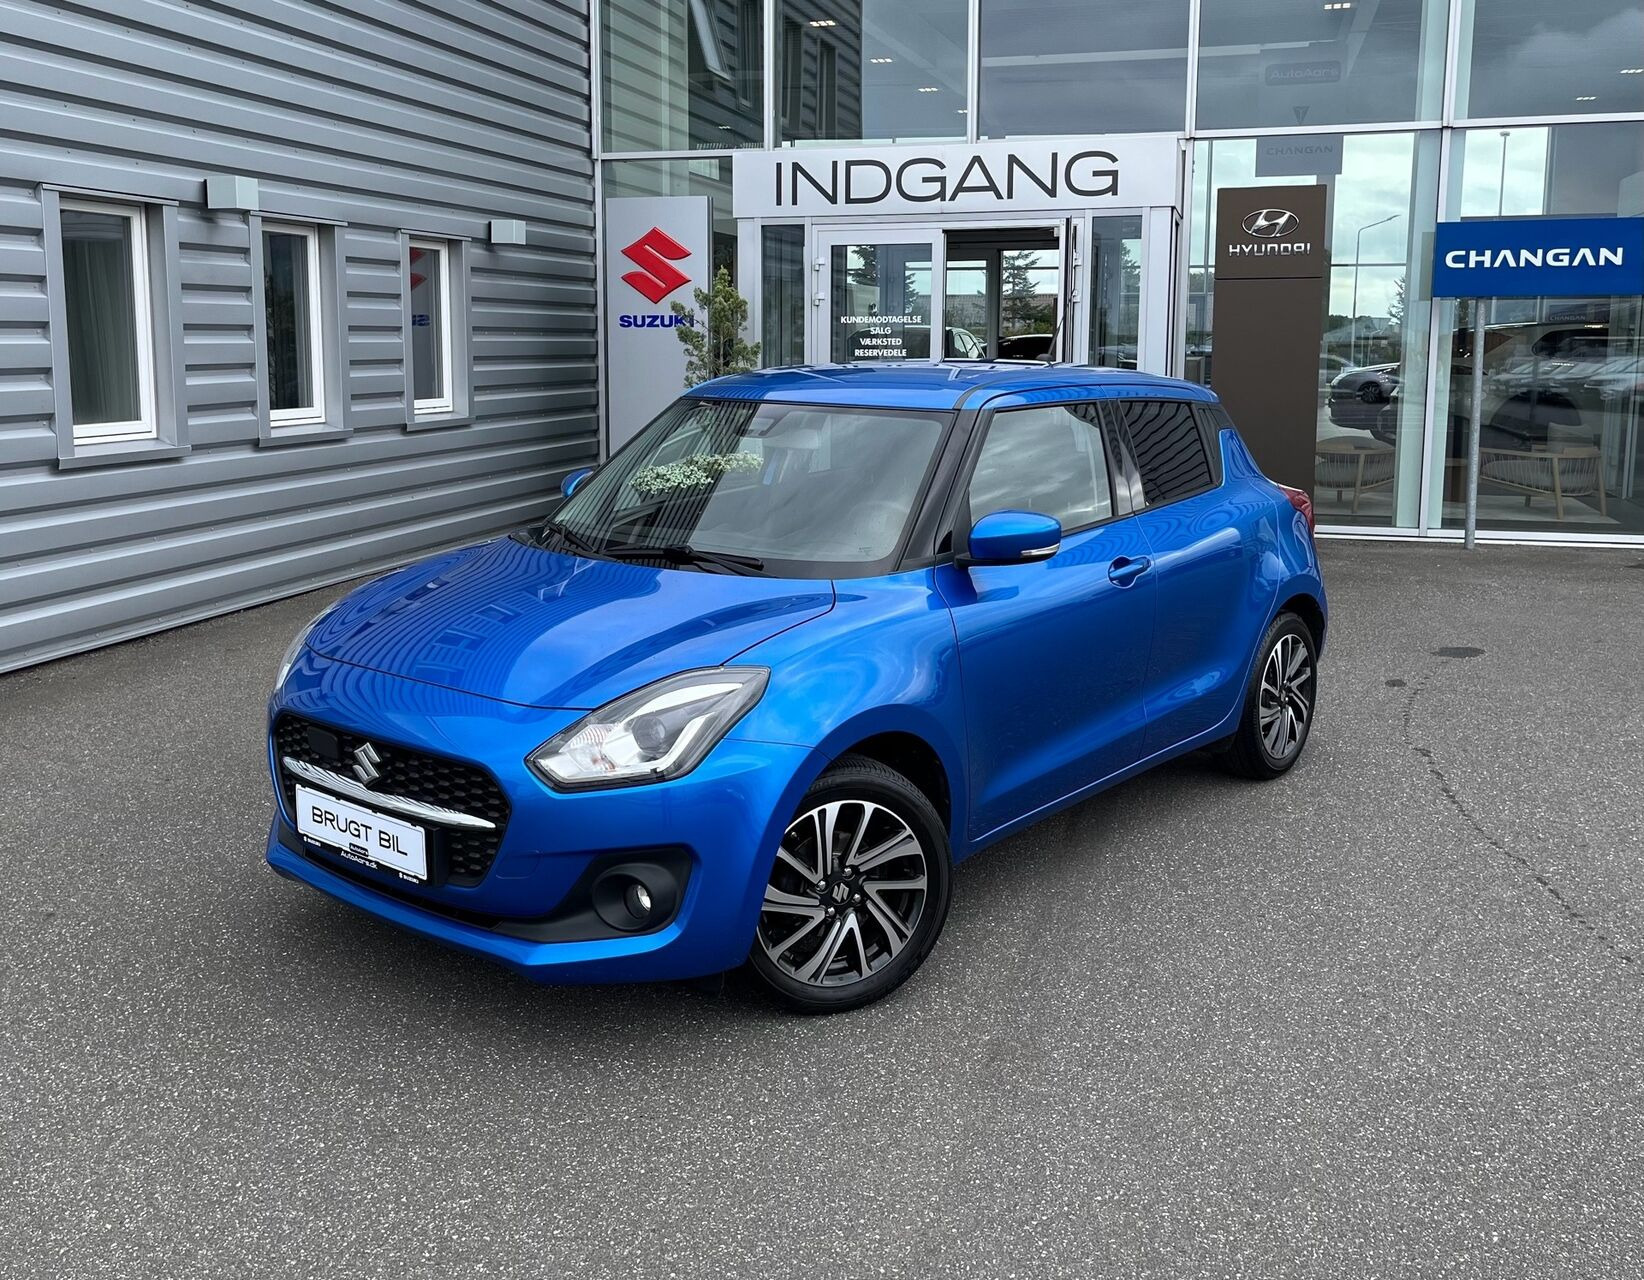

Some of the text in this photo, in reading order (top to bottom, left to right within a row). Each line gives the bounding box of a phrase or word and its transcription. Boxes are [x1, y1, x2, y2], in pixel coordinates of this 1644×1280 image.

[1266, 145, 1333, 156] CHANGAN
[776, 150, 1119, 206] INDGANG
[1229, 242, 1311, 256] HYUNDAI
[1445, 247, 1623, 268] CHANGAN
[840, 315, 922, 324] KUNDEMODTAGELSE
[870, 327, 892, 335] SALG
[860, 338, 902, 346] VÆRKSTED
[854, 349, 907, 357] RESERVEDELE
[312, 805, 408, 856] BRUGT BIL
